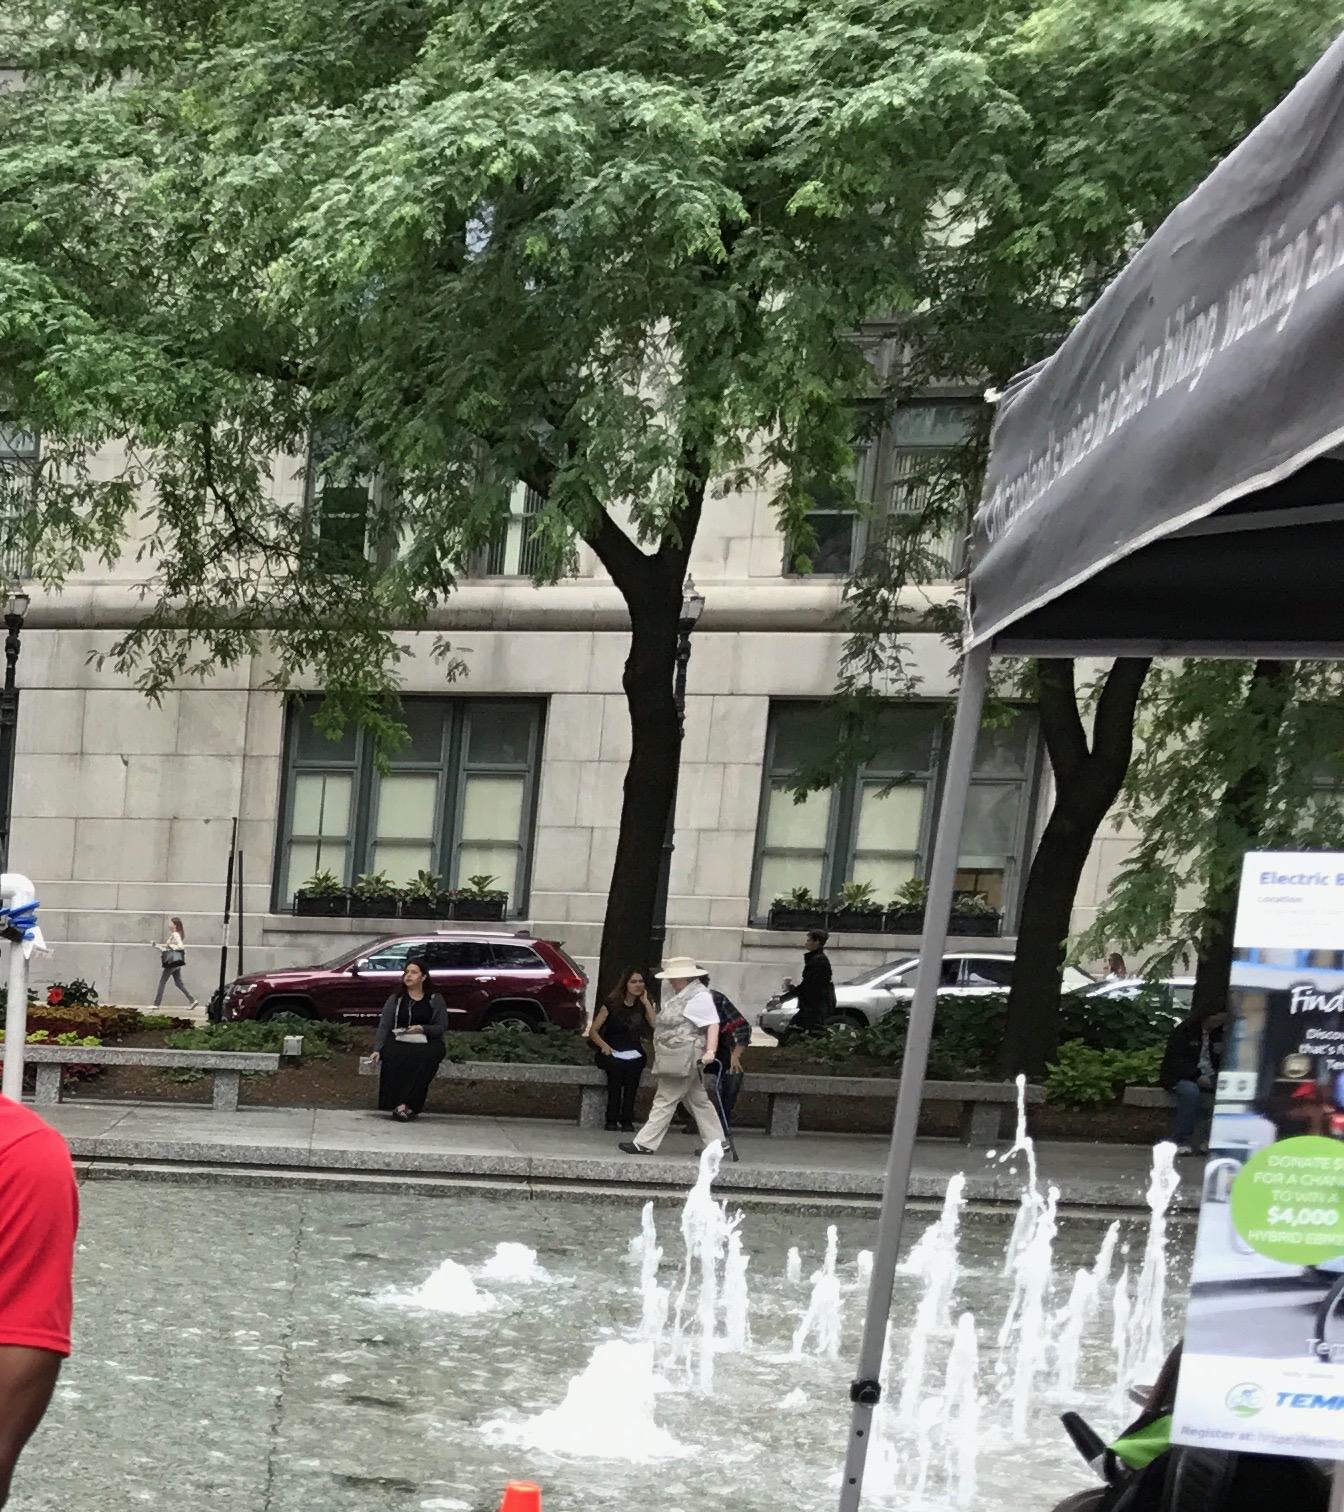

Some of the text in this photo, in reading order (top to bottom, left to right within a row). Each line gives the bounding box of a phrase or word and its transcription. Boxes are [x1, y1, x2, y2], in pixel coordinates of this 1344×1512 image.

[1219, 222, 1308, 351] walking
[1259, 871, 1330, 886] Electric
[1268, 1155, 1329, 1170] DONATE
[1254, 1172, 1284, 1184] FOR
[1272, 1189, 1292, 1202] TO
[1267, 1206, 1339, 1227] $4,000
[1247, 1230, 1302, 1244] HYBRID
[1181, 1425, 1236, 1440] Register
